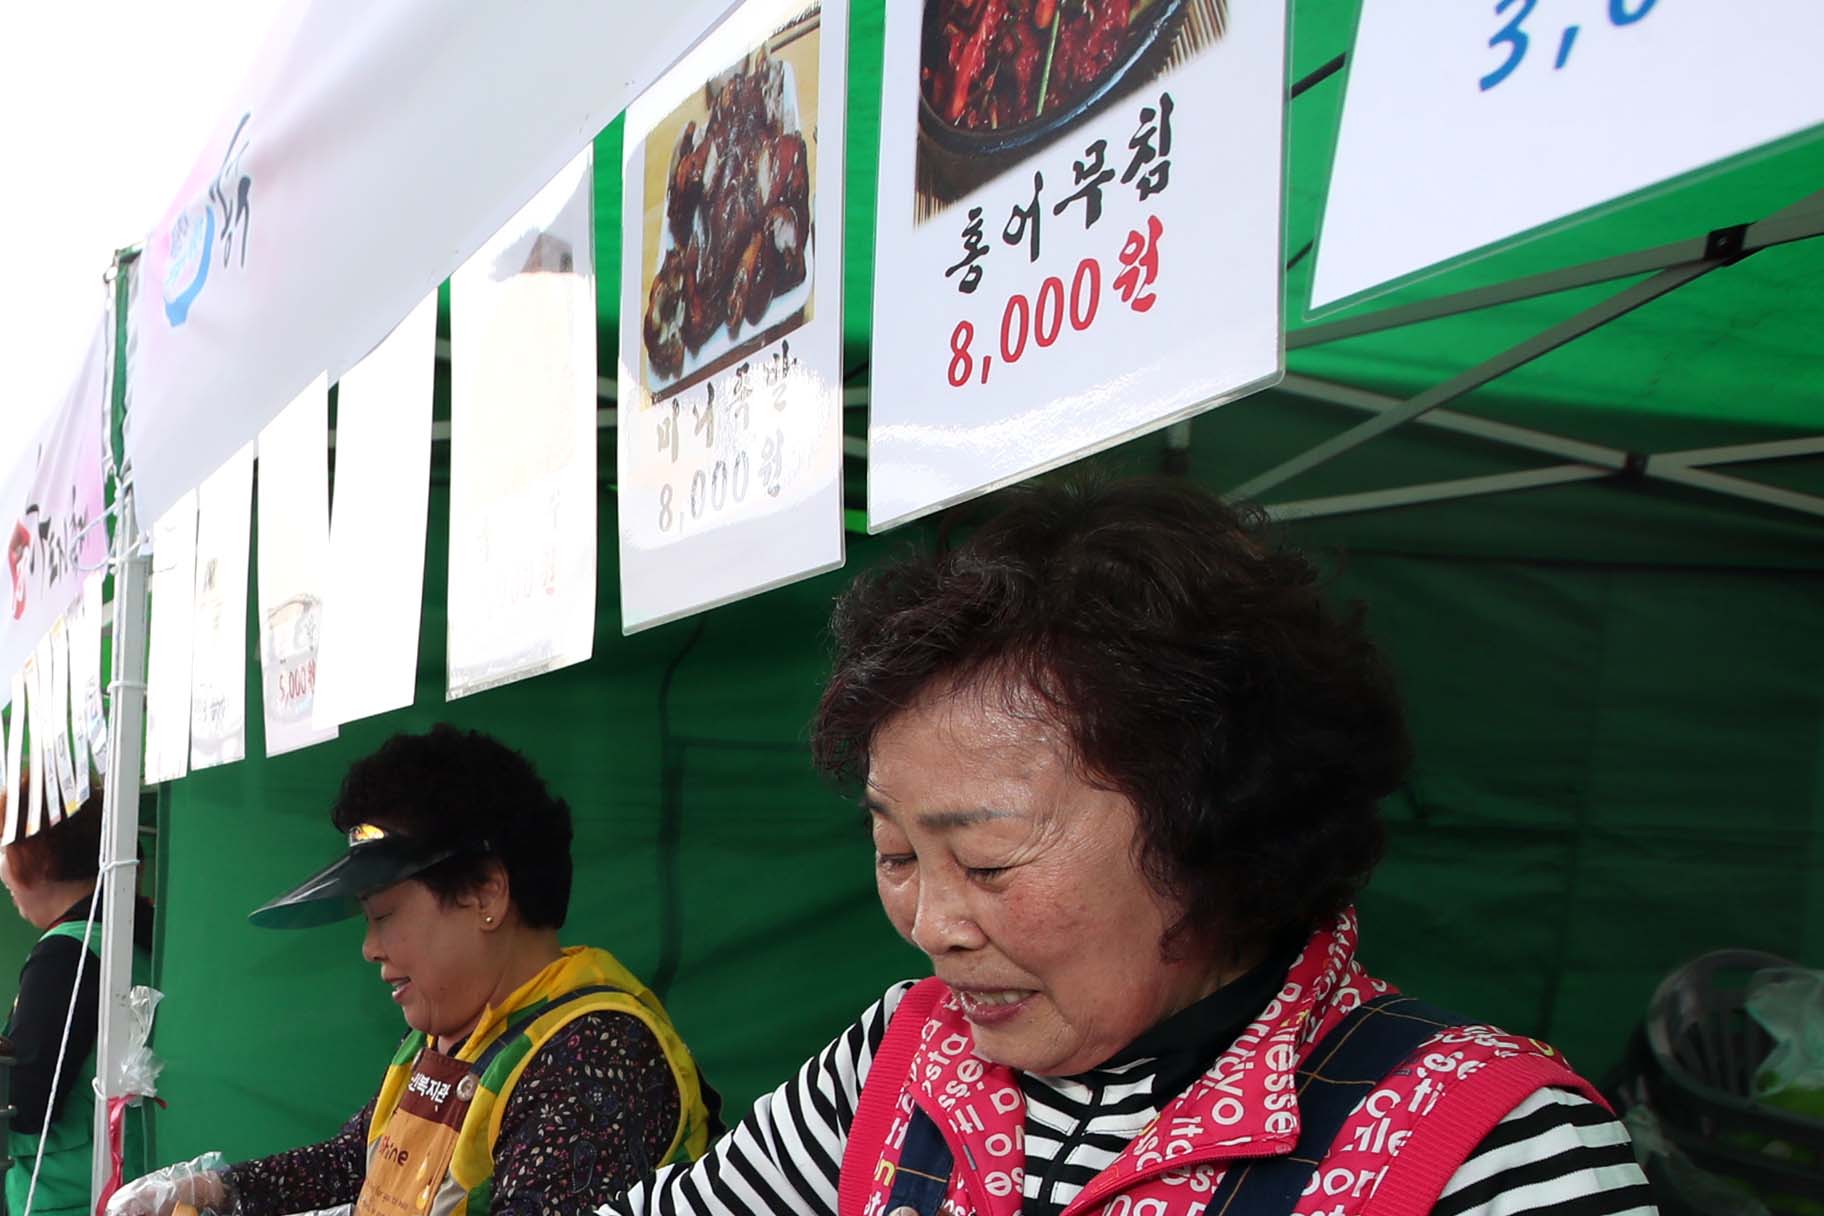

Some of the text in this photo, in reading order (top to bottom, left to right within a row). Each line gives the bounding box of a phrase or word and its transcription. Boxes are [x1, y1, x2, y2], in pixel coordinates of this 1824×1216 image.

[945, 92, 1174, 293] 홍어무침
[948, 215, 1163, 387] 8,000원
[659, 428, 784, 532] 8,000원
